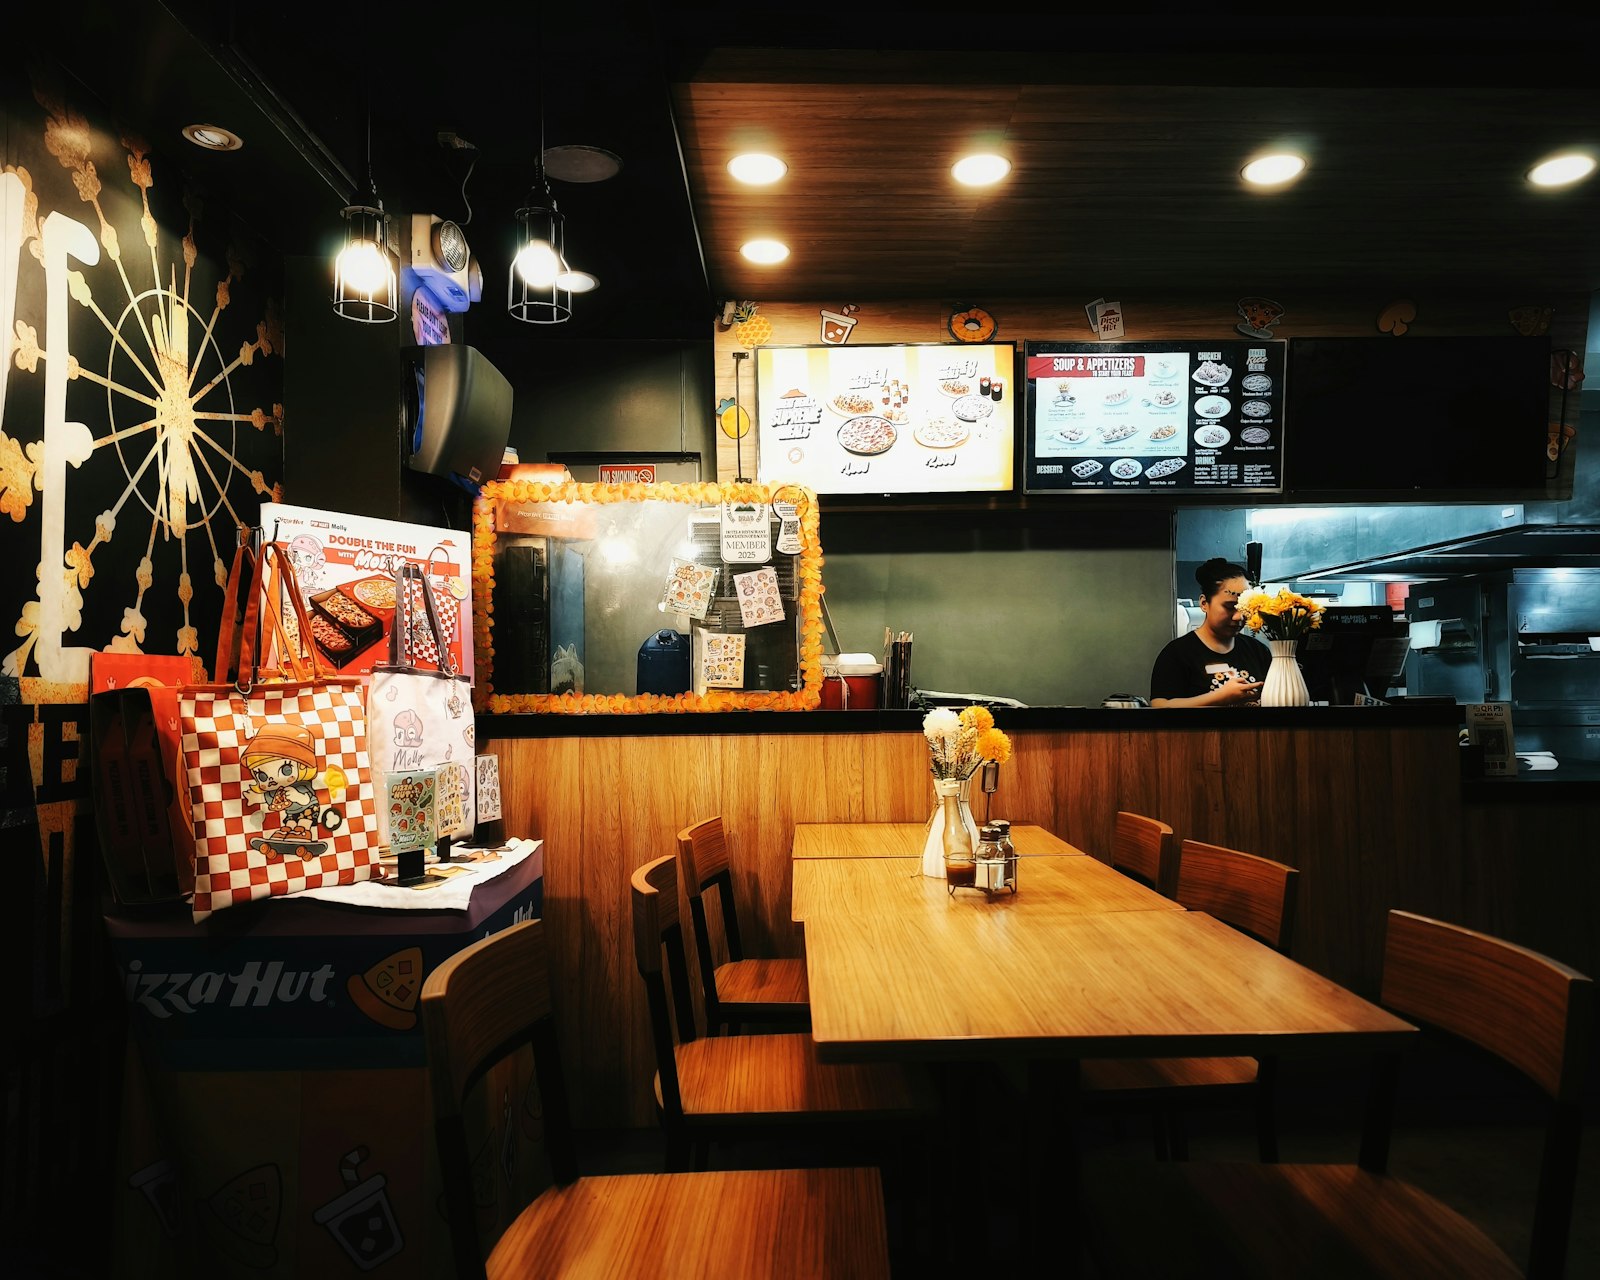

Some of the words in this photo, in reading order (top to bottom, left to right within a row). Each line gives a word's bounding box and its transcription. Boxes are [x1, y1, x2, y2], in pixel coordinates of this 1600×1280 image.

[1100, 316, 1120, 325] Pizza
[1053, 358, 1075, 371] SOUP
[1077, 358, 1086, 371] &
[1087, 357, 1135, 371] APPETIZERS
[1036, 465, 1063, 474] DESSERTS
[602, 470, 611, 484] NO
[612, 470, 638, 484] SMOKING
[331, 524, 347, 532] Molly
[329, 534, 373, 549] DOUBLE
[375, 540, 394, 553] THE
[396, 543, 416, 555] FUN
[726, 541, 767, 550] MEMBER
[338, 551, 355, 559] WITH
[737, 551, 756, 559] 2025
[393, 749, 425, 771] Molly
[125, 959, 228, 1018] izza
[228, 960, 335, 1007] Hut
